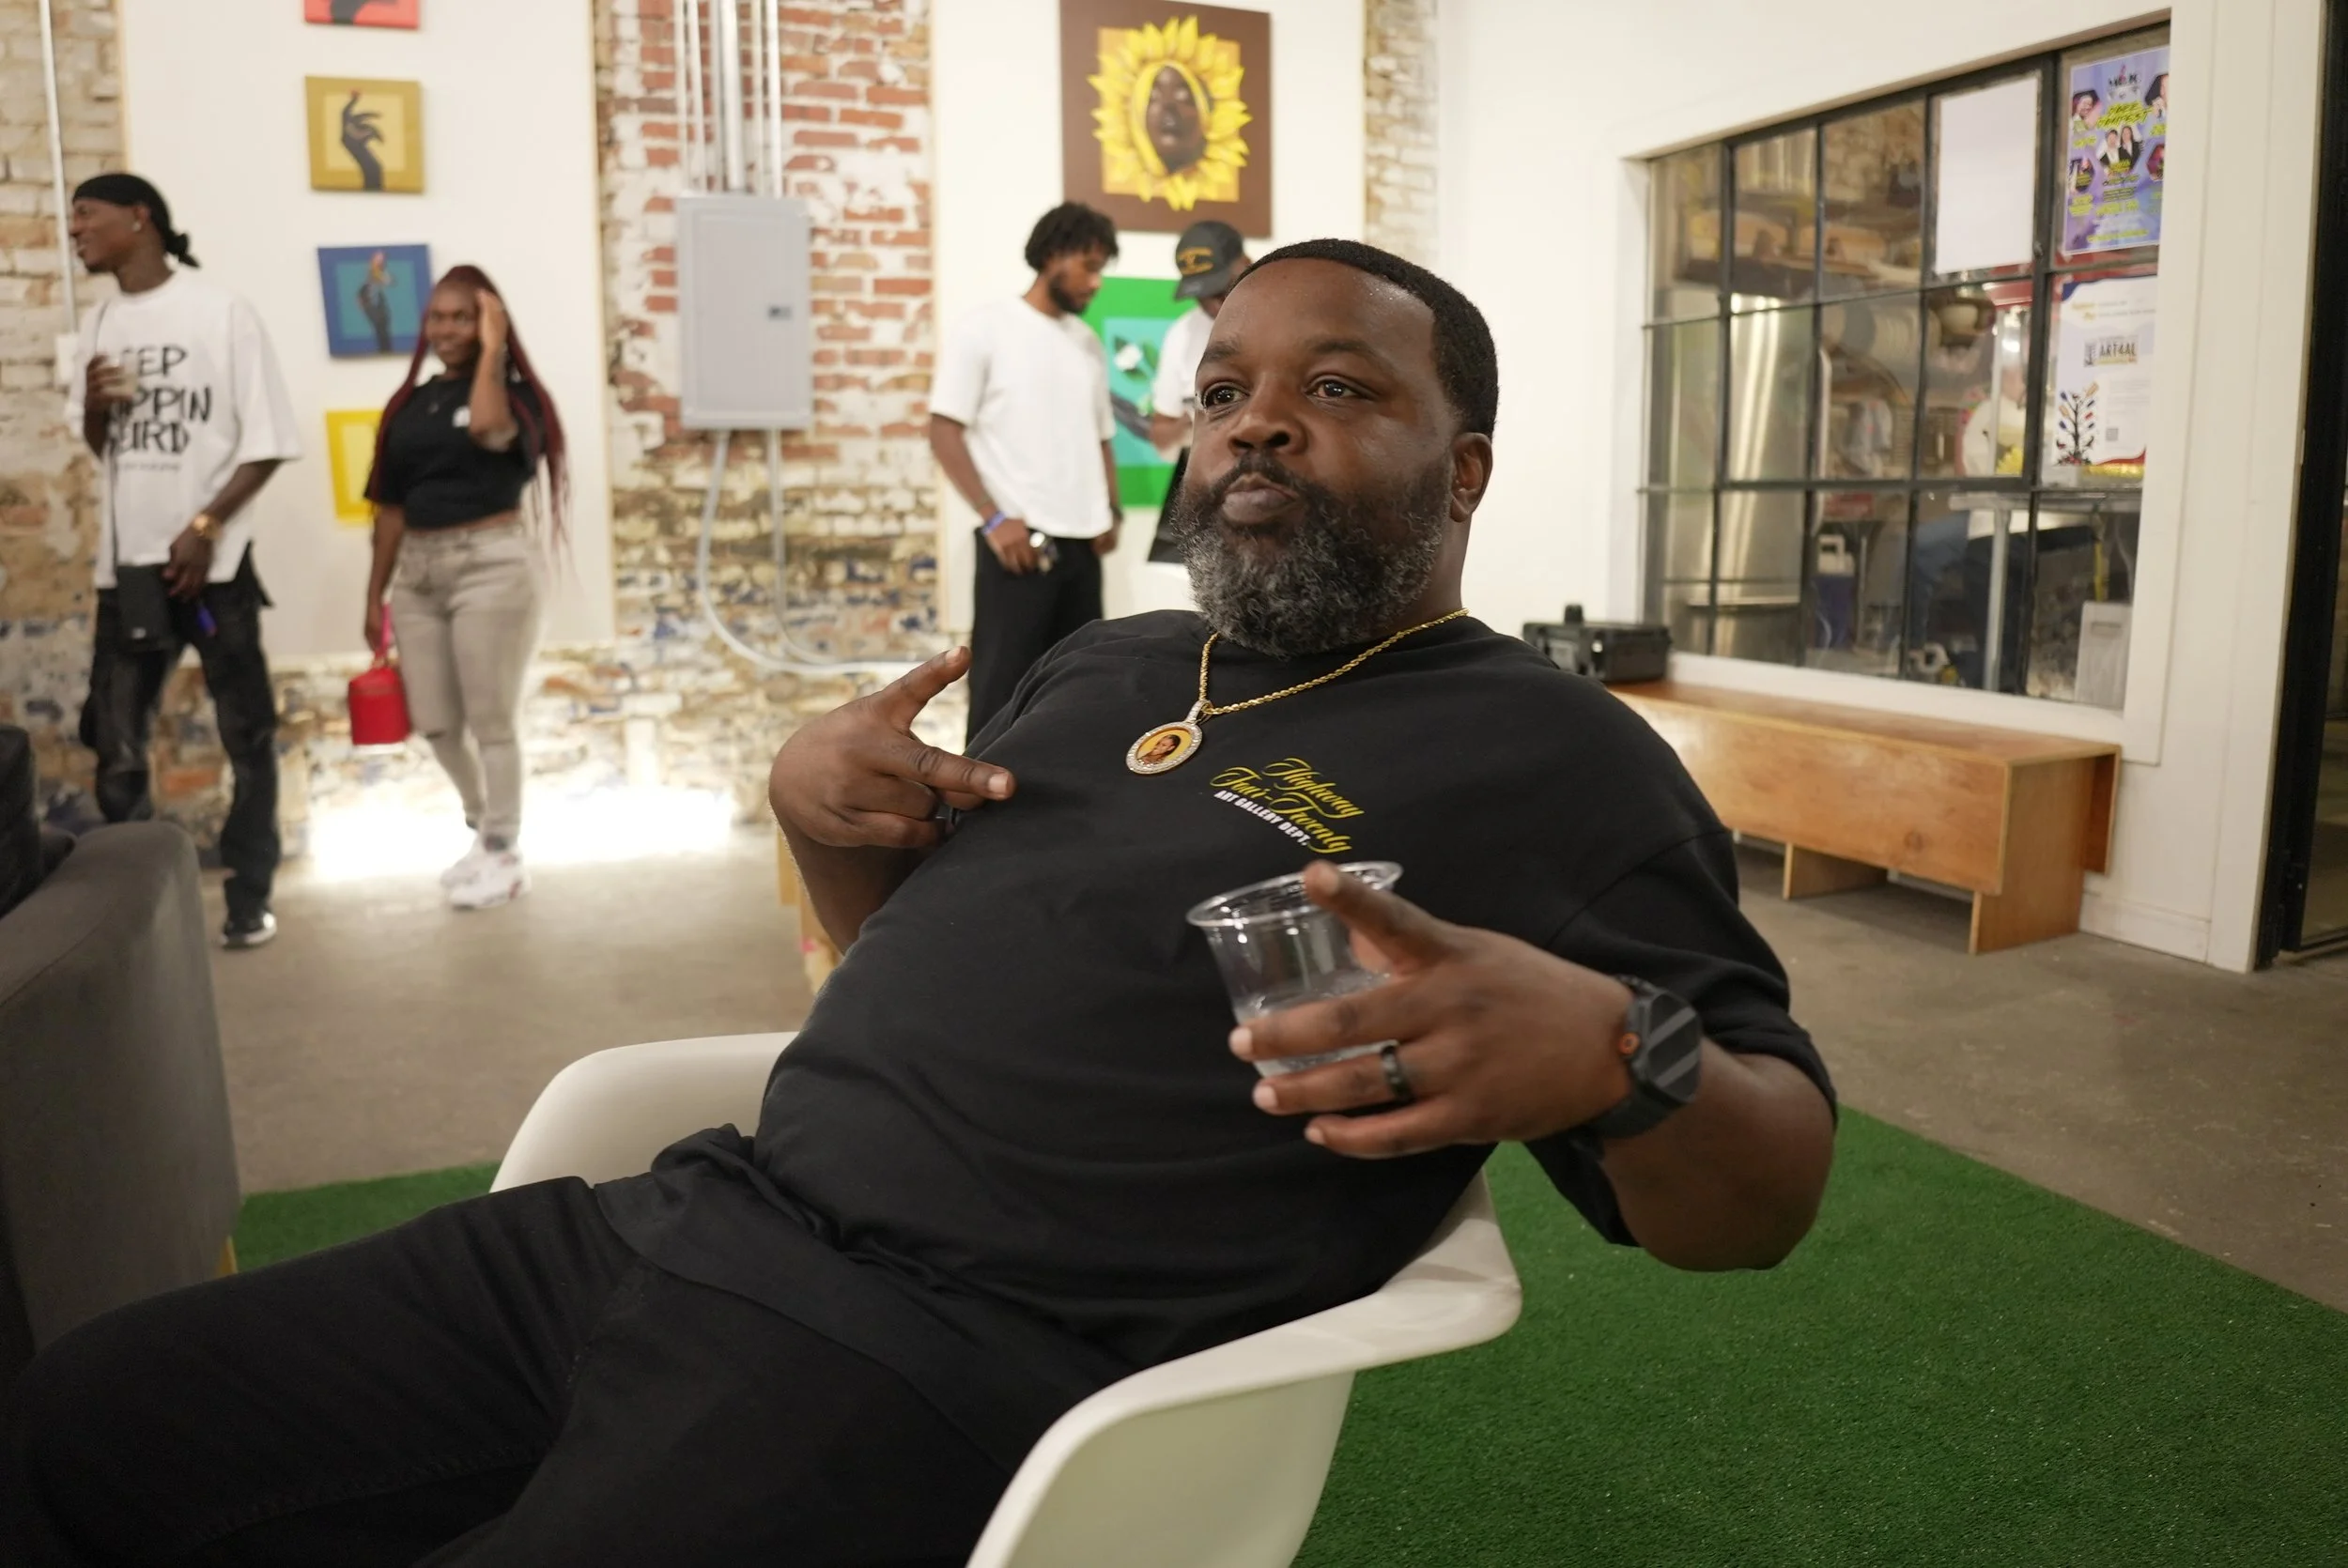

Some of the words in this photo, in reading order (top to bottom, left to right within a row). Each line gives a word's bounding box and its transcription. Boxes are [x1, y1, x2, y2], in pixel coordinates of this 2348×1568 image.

[1261, 757, 1365, 819] Highway
[1213, 790, 1239, 803] ART
[1234, 796, 1284, 824] GALLERY
[1277, 821, 1312, 846] DEPT.
